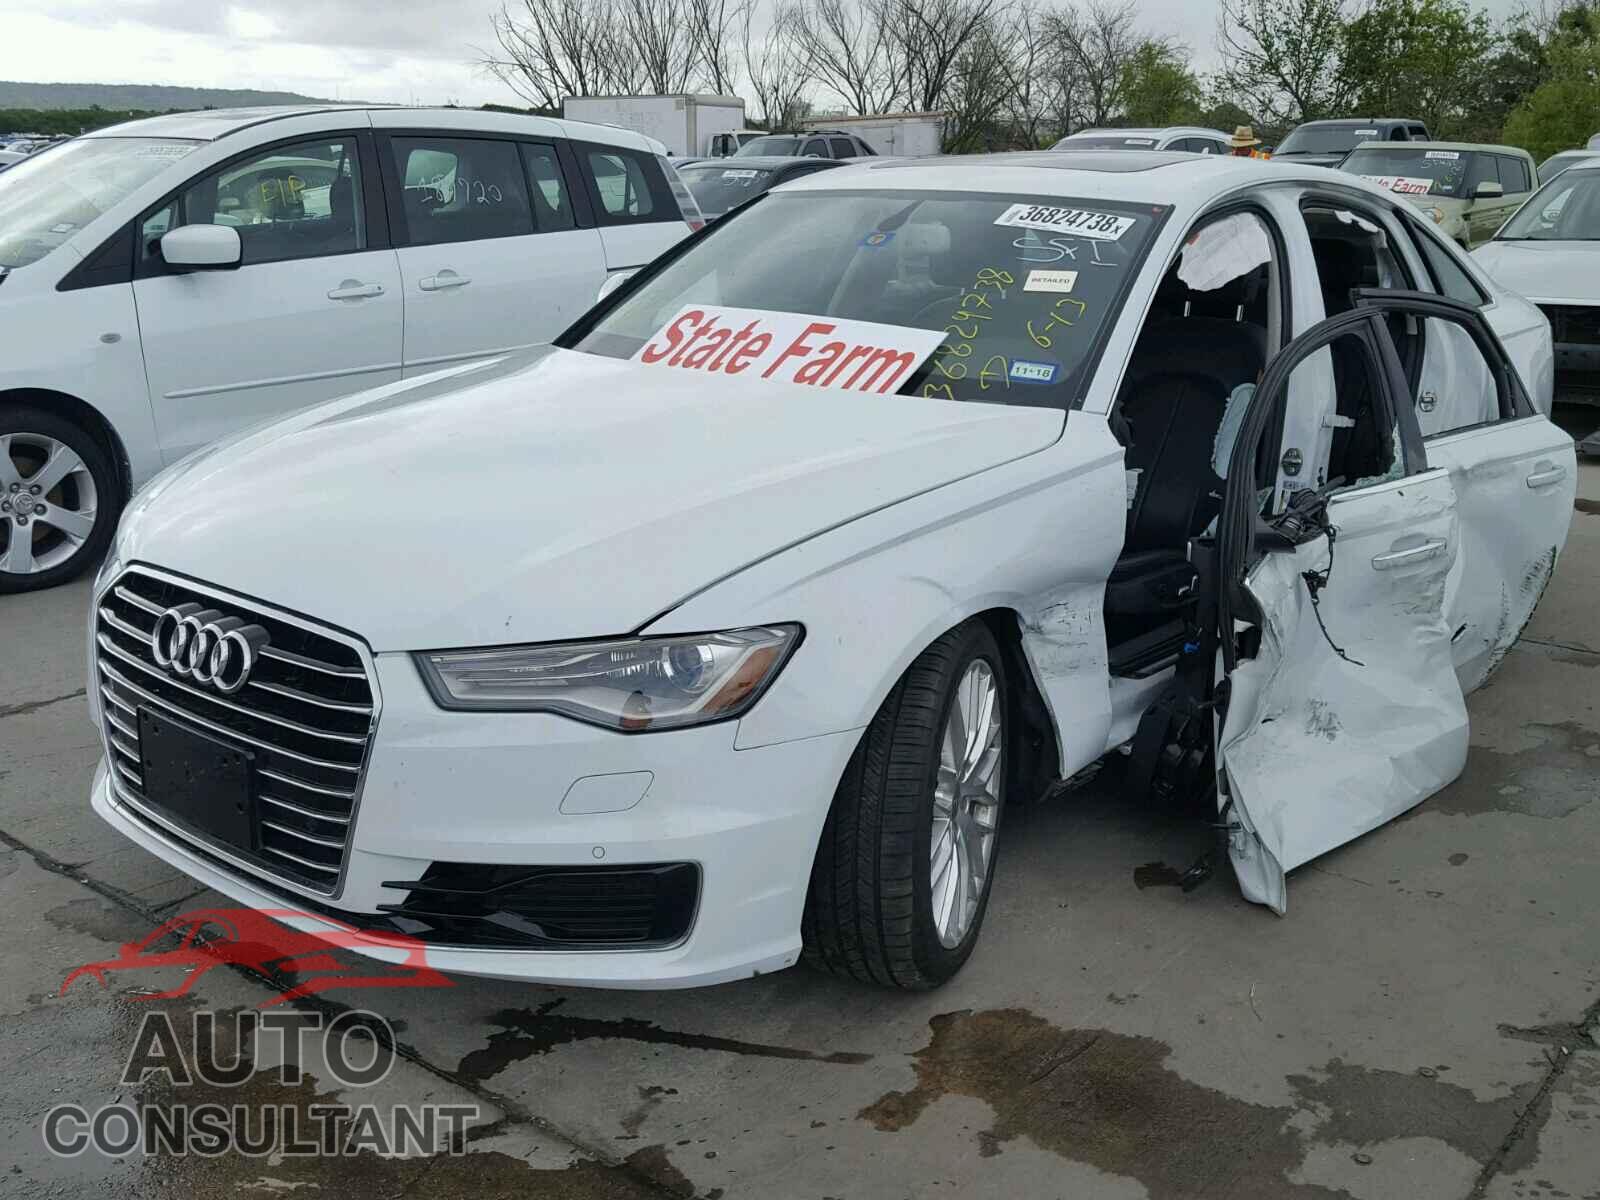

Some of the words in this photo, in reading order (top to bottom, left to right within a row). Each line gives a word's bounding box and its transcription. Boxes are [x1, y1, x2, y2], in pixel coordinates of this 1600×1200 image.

[640, 310, 774, 375] State
[760, 322, 916, 395] Farm
[1015, 366, 1052, 378] 11-18
